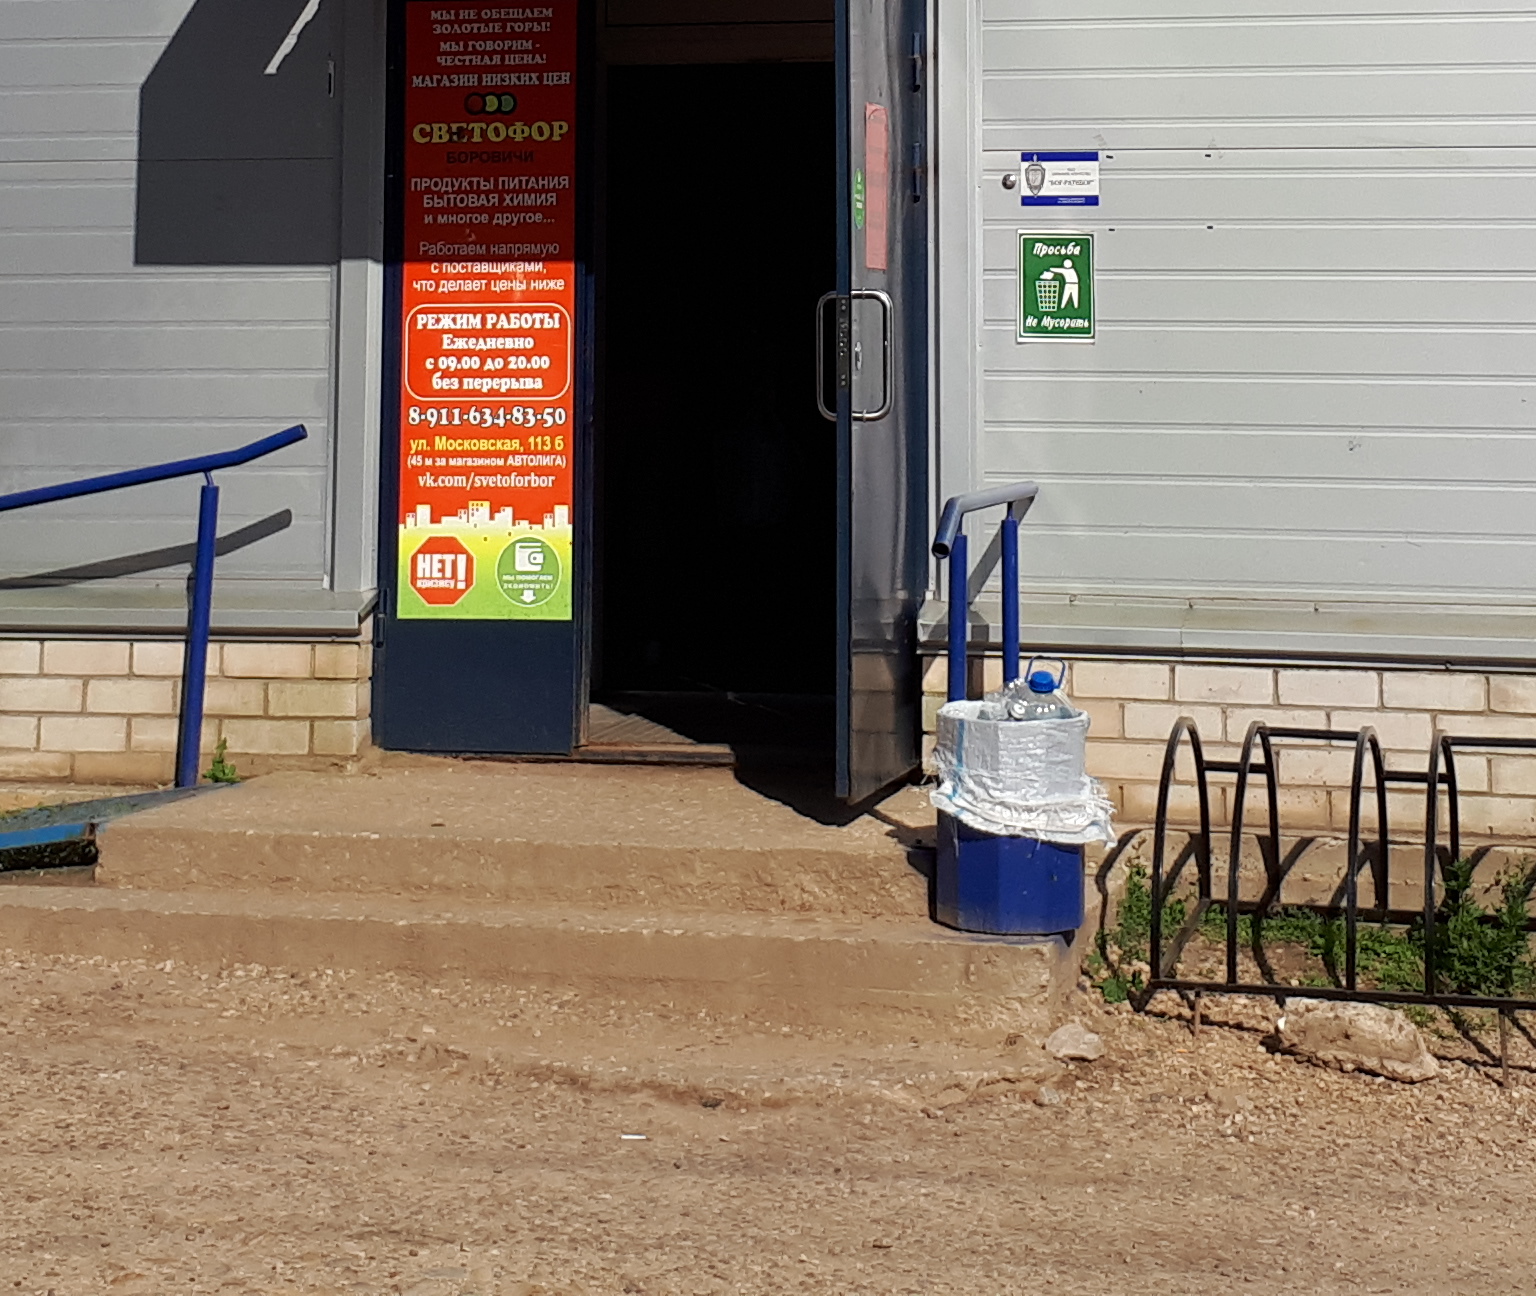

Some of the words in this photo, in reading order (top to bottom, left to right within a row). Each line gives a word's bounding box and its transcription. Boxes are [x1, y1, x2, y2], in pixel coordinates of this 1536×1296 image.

[430, 10, 455, 21] МЫ
[459, 9, 478, 20] НЕ
[481, 8, 553, 20] ОБЕЩАЕМ
[432, 23, 503, 35] ЗОЛОТЫЕ
[506, 22, 551, 33] ГОРЫ!
[439, 41, 464, 52] МЫ
[467, 40, 533, 51] ГОВОРИМ
[436, 55, 501, 66] ЧЕСТНАЯ
[504, 54, 547, 65] ЦЕНА!
[412, 74, 478, 88] МАГАЗИН
[482, 73, 539, 86] НИЗКИХ
[543, 72, 571, 86] ЦЕН
[413, 121, 569, 144] СВЕТОФОР
[446, 151, 535, 164] БОРОВИЧИ
[410, 177, 494, 193] ПРОДУКТЫ
[498, 176, 569, 190] ПИТАНИЯ
[423, 193, 499, 208] БЫТОВАЯ
[503, 193, 557, 206] ХИМИЯ
[424, 214, 433, 224] и
[437, 213, 489, 224] многое
[492, 212, 556, 226] другое...
[419, 242, 486, 255] Работаем
[490, 243, 560, 258] напрямую
[1033, 241, 1081, 258] Просьба
[430, 263, 439, 274] с
[442, 261, 547, 275] поставщиками,
[413, 280, 436, 291] что
[438, 278, 487, 293] делает
[490, 279, 527, 292] цены
[530, 279, 565, 291] ниже
[416, 314, 482, 329] РЕЖИМ
[485, 313, 561, 329] РАБОТЫ
[1025, 315, 1038, 327] Не
[1041, 315, 1089, 330] Мусорить
[442, 334, 535, 351] Ежедневно
[425, 357, 435, 369] с
[438, 356, 481, 371] 09.00
[483, 357, 505, 371] до
[507, 356, 551, 369] 20.00
[431, 371, 459, 389] без
[462, 377, 543, 392] перерыва
[408, 406, 566, 428] 8-911-634-83-50
[409, 438, 431, 453] ул.
[434, 436, 524, 452] Московская,
[528, 436, 552, 451] 113
[554, 435, 564, 451] б
[407, 455, 423, 468] (45
[425, 458, 433, 466] м
[434, 458, 446, 466] за
[449, 457, 504, 467] магазином
[506, 455, 567, 468] АВТОЛИГА)
[418, 472, 556, 491] vk.com/svetoforbor
